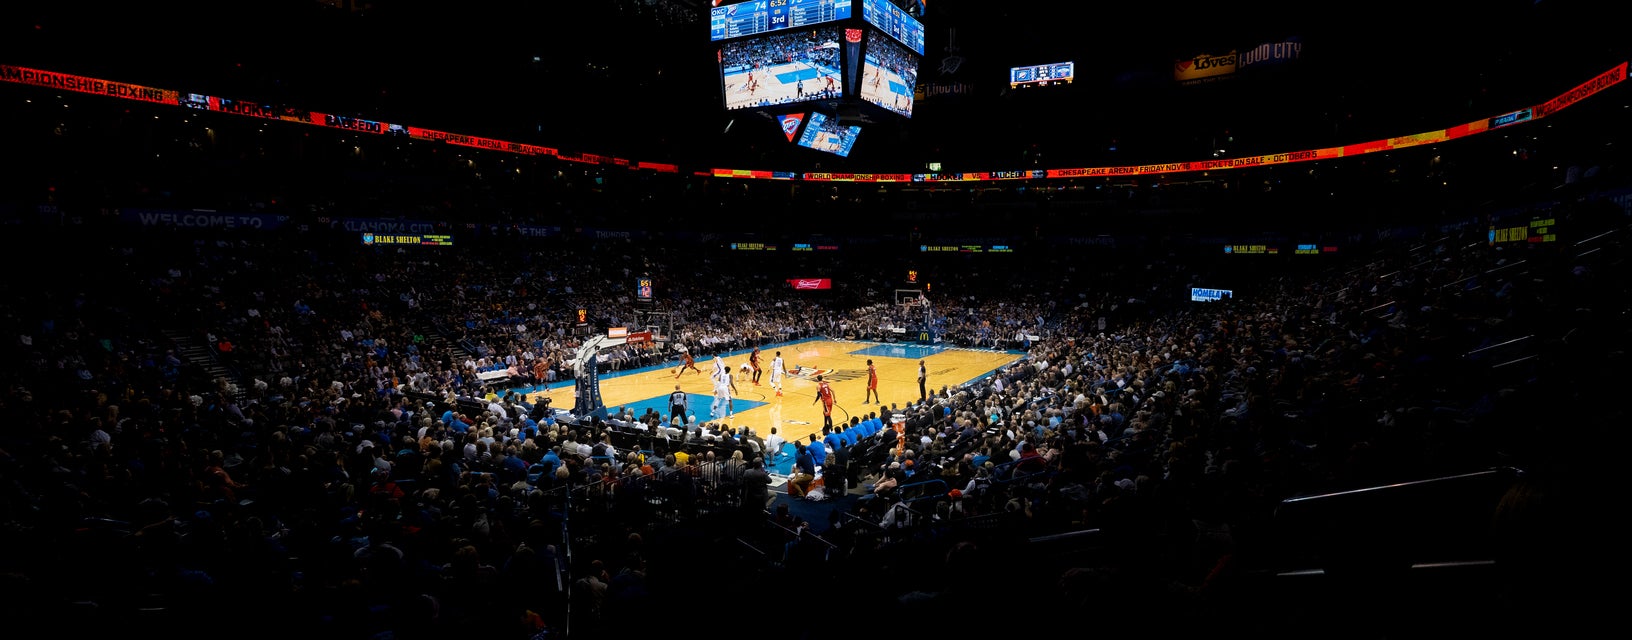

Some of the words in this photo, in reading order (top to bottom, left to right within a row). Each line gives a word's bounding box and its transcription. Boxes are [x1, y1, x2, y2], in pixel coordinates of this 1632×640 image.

[755, 1, 767, 11] 74
[772, 15, 785, 24] 3rd
[1274, 41, 1303, 60] CITY
[107, 83, 164, 102] BOXING
[422, 130, 475, 146] CHESAPEAKE
[478, 140, 503, 150] ARENA
[1058, 167, 1106, 177] CHESAPEAKE
[1108, 166, 1134, 175] ARENA
[1139, 164, 1165, 173] FRIDAY
[1165, 163, 1182, 171] NOV
[1201, 159, 1233, 169] TICKETS
[1234, 158, 1244, 167] ON
[1245, 156, 1264, 165] SALE
[1273, 151, 1310, 163] OCTOBER
[808, 172, 831, 180] WORLD
[832, 173, 878, 181] CHAMPIONSHIP
[880, 173, 905, 181] BOXING
[138, 212, 236, 229] WELCOME
[239, 216, 264, 229] TO
[375, 235, 394, 244] BLAKE
[396, 235, 421, 244] SHELTON
